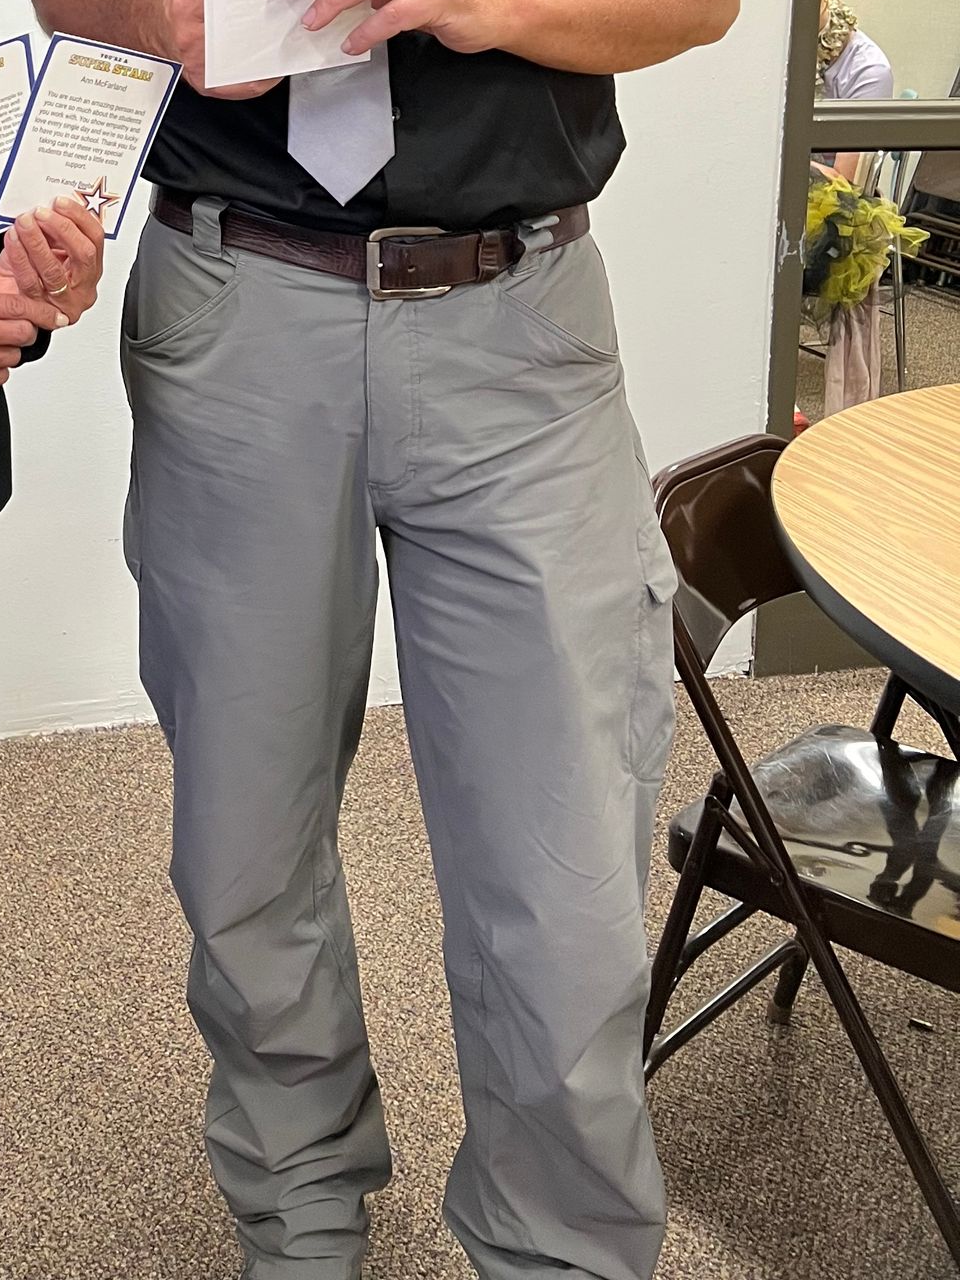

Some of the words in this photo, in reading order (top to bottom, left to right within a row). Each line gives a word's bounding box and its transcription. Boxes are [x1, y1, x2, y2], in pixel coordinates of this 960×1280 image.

[68, 54, 111, 72] SUPER
[112, 64, 154, 82] STAR!
[81, 76, 94, 85] Ann
[94, 79, 128, 92] McFarland
